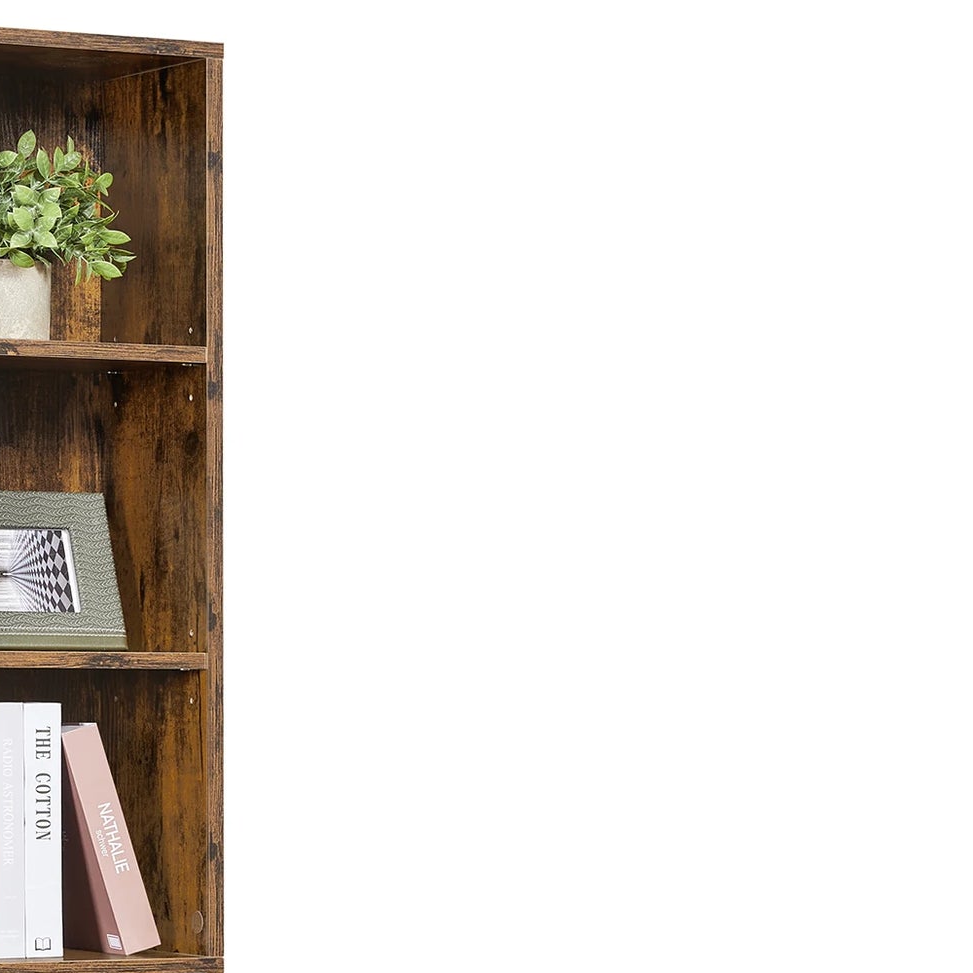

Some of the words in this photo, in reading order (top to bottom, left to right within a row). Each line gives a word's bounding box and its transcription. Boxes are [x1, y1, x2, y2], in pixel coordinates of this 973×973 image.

[2, 738, 14, 778] RADIO
[35, 726, 51, 760] THE
[2, 782, 15, 866] ASTRONOMER
[35, 772, 51, 841] COTTON
[98, 802, 130, 874] NATHALIE
